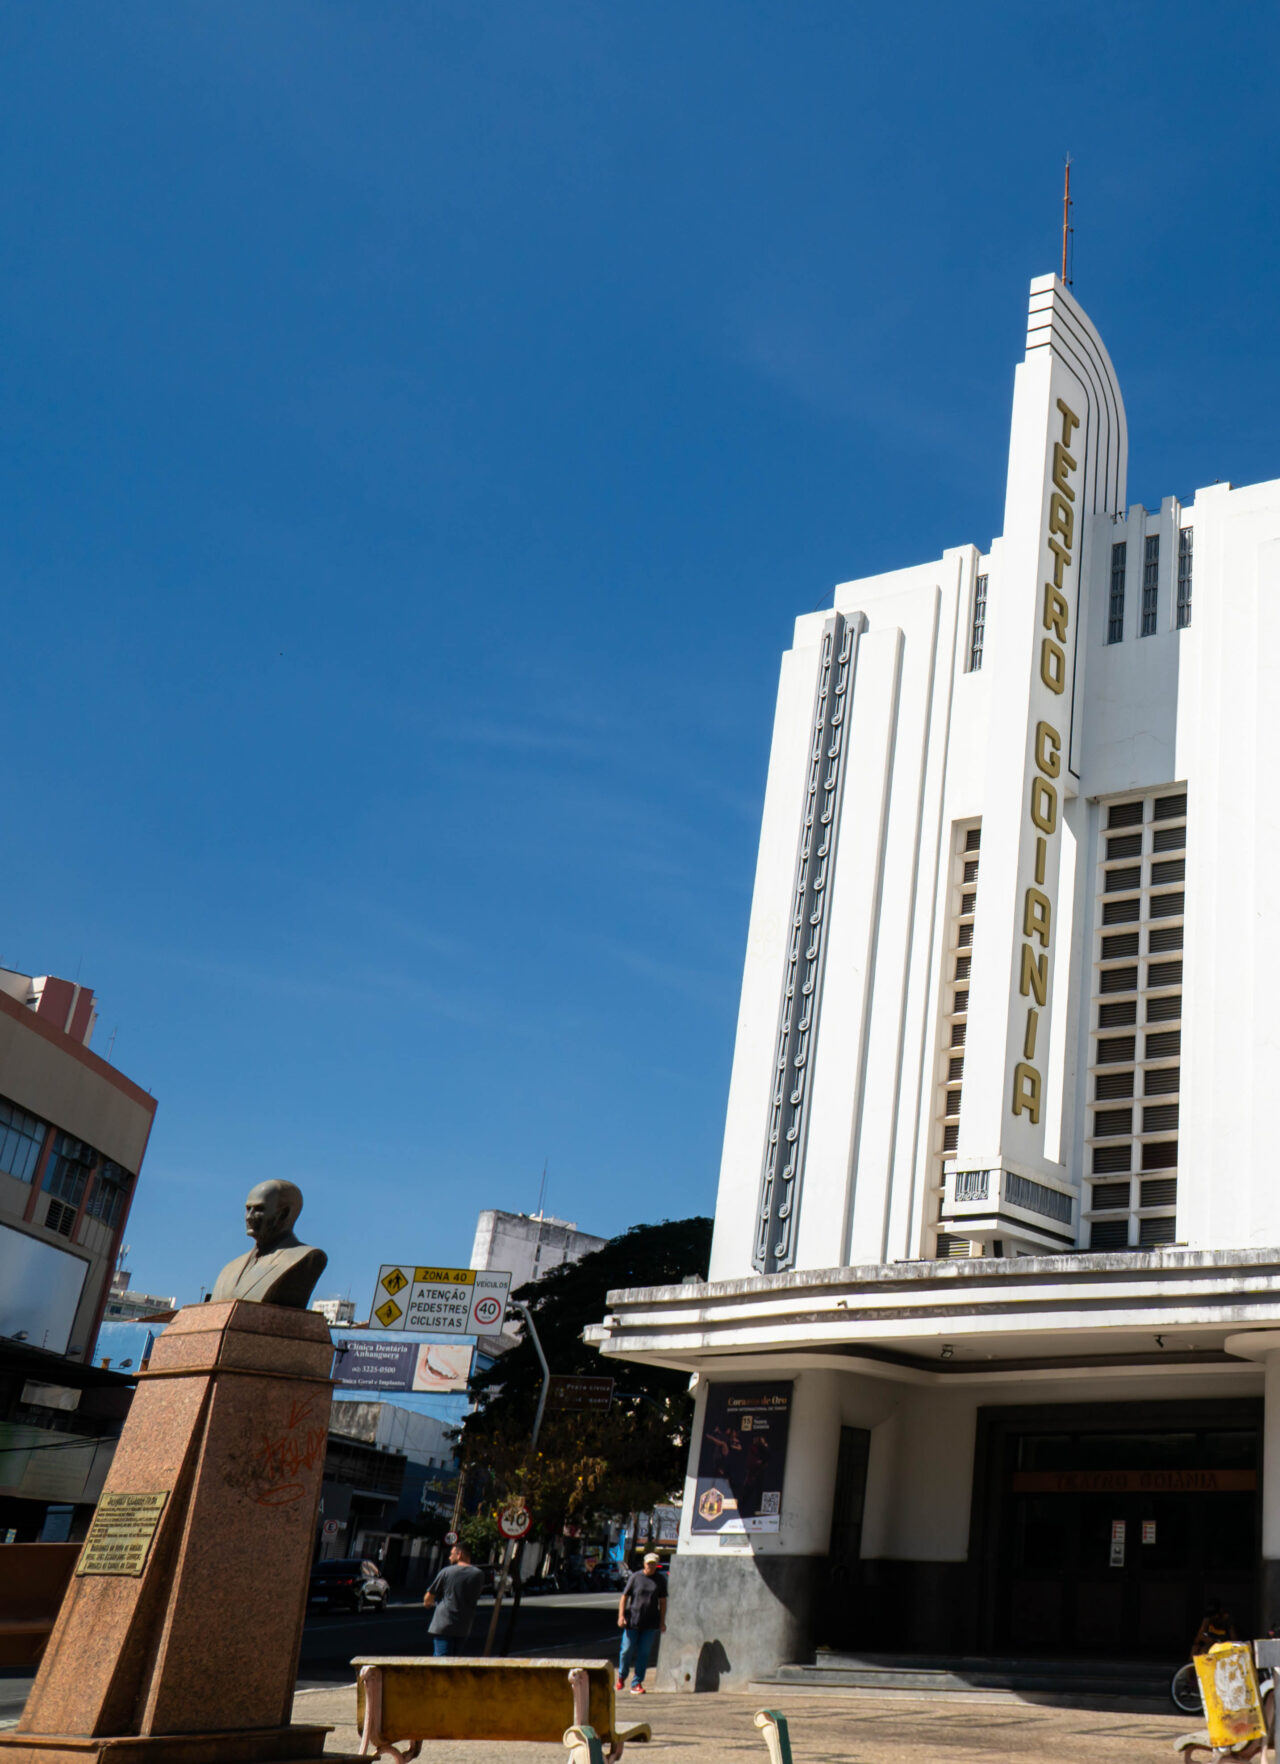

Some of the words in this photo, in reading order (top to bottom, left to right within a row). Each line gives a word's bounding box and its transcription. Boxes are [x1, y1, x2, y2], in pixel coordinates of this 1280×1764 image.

[1041, 398, 1080, 695] TEATRO
[1012, 720, 1061, 1125] GOIANIA
[422, 1271, 450, 1281] ZONA
[453, 1272, 467, 1282] 40
[417, 1288, 466, 1302] ATENÇÃO
[410, 1302, 468, 1314] PEDESTRES
[479, 1302, 496, 1315] 40
[410, 1316, 462, 1327] CICLISTAS
